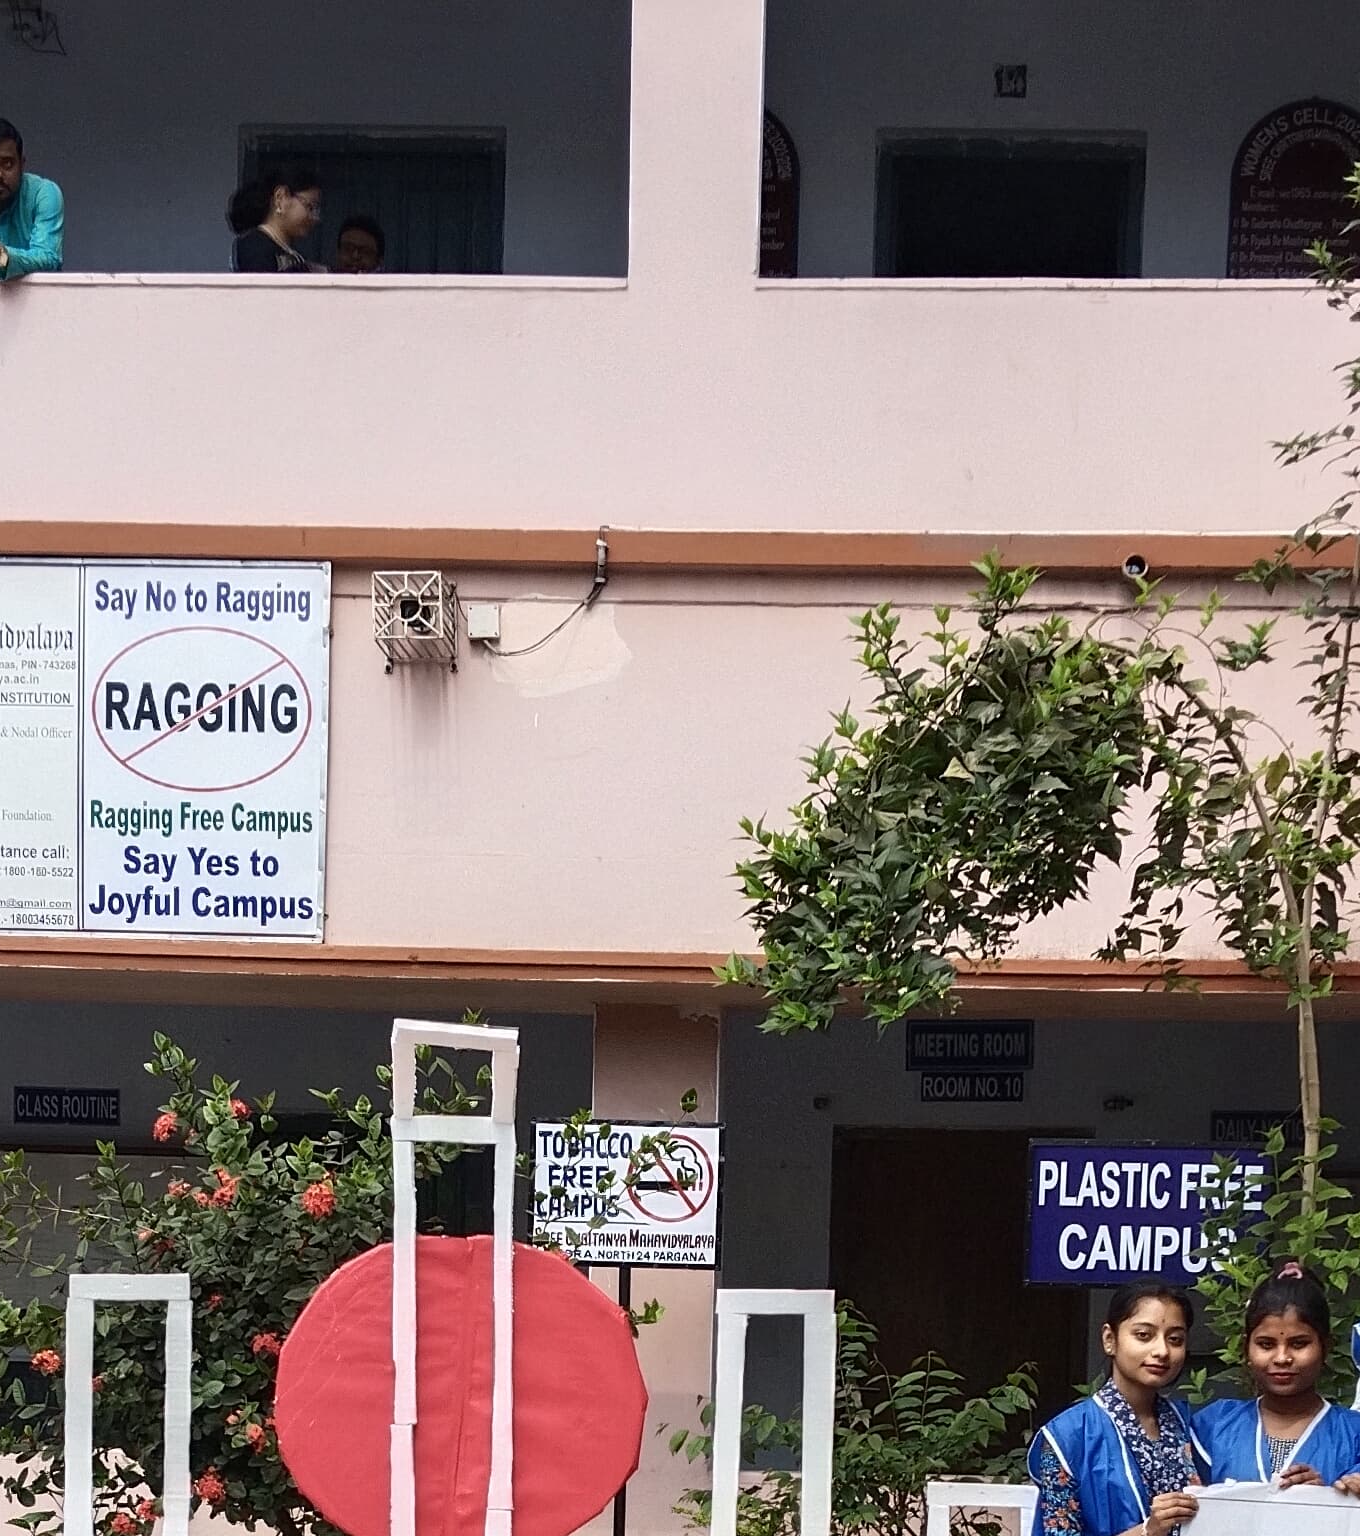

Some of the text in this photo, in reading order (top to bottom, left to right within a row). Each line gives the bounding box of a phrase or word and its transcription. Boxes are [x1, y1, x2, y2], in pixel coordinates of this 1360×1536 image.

[1292, 107, 1333, 125] CELL
[95, 579, 311, 622] Say No to Ragging
[105, 681, 298, 734] RAGGING
[0, 726, 8, 737] &
[11, 726, 38, 738] Nodal
[41, 727, 72, 739] Officer
[90, 800, 313, 839] Ragging Free Campus
[42, 844, 70, 860] call:
[124, 845, 279, 882] Say Yes to
[89, 884, 313, 926] Joyful Campus
[913, 1032, 1025, 1057] MEETING ROOM
[923, 1076, 1022, 1098] ROOM NO. 10
[16, 1094, 117, 1119] CLASS ROUTINE
[1215, 1119, 1257, 1141] DAILY
[1038, 1160, 1172, 1209] PLASTIC
[653, 1251, 706, 1262] PARGANA
